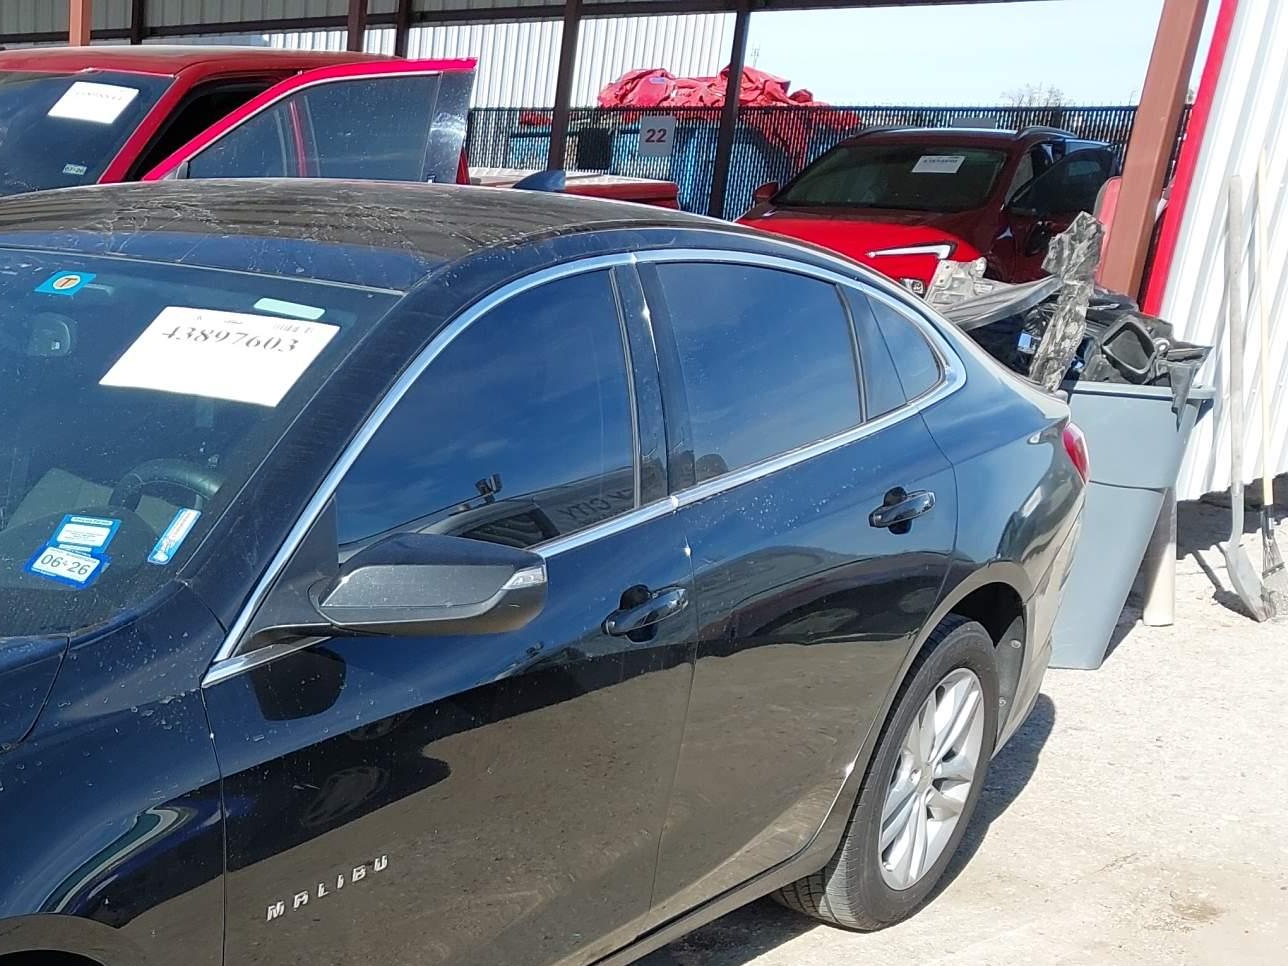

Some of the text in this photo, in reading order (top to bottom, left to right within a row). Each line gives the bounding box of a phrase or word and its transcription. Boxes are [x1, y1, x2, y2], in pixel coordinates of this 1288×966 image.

[645, 128, 667, 143] 22
[162, 326, 298, 352] 43897603
[40, 553, 64, 568] 06
[66, 561, 91, 576] 26
[266, 855, 388, 921] MALIBU
